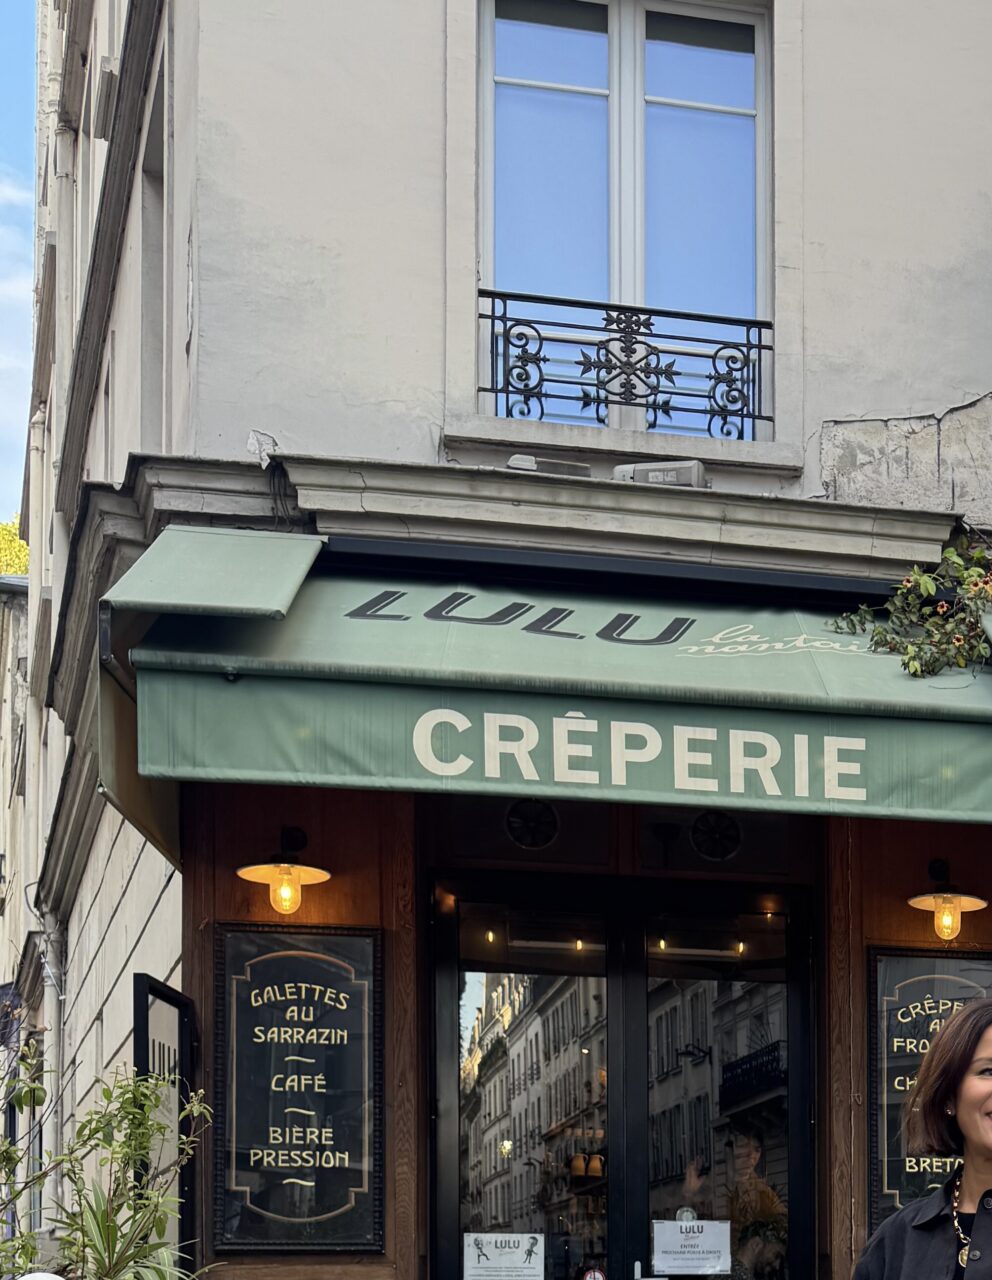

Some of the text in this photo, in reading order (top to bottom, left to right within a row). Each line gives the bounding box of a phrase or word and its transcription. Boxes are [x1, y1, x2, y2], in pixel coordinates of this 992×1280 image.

[344, 590, 697, 646] LULU
[701, 624, 769, 643] la
[679, 634, 869, 653] nantai
[413, 709, 867, 801] CRÊPERIE
[250, 982, 350, 1010] GALETTES
[285, 1005, 314, 1021] AU
[253, 1027, 348, 1045] SARRAZIN
[271, 1073, 327, 1092] CAFÉ
[269, 1125, 334, 1145] BIÈRE
[250, 1150, 349, 1168] PRESSION
[680, 1225, 704, 1235] LULU
[494, 1239, 520, 1250] LULU
